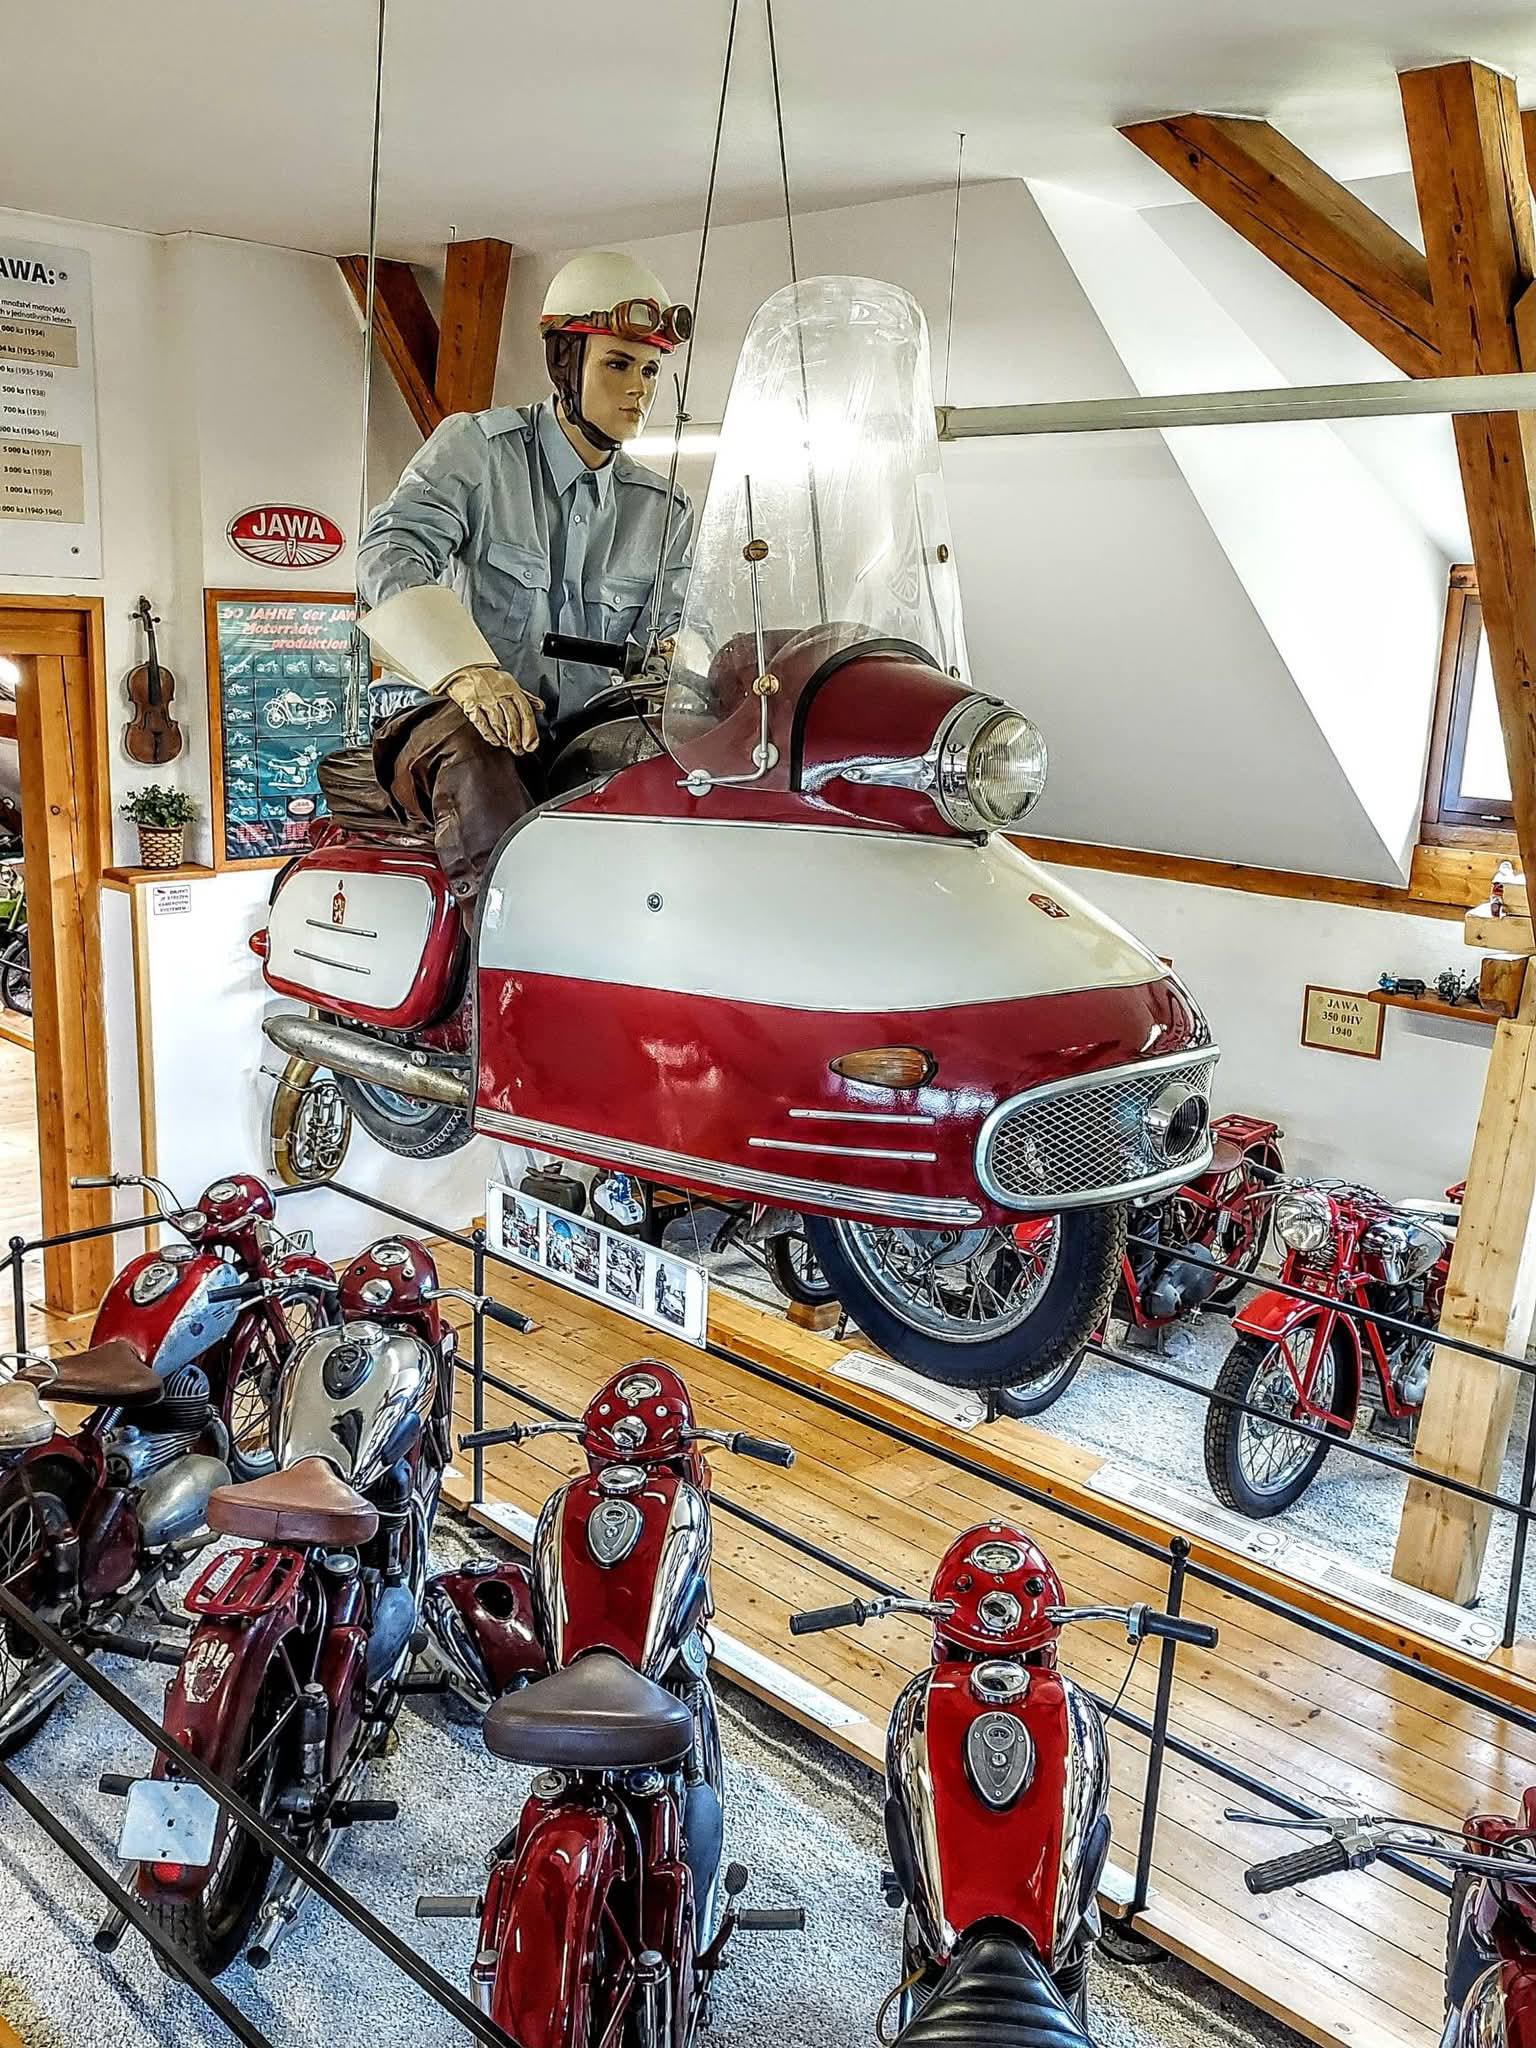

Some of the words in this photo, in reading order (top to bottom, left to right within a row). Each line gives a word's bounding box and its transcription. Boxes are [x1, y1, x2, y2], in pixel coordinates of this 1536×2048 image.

[252, 512, 325, 540] JAWA
[247, 608, 297, 620] JAHRE
[303, 609, 326, 621] der
[271, 638, 348, 651] produktion
[1327, 999, 1360, 1012] JAWA
[1322, 1011, 1338, 1021] 350
[1331, 1025, 1352, 1037] 1940
